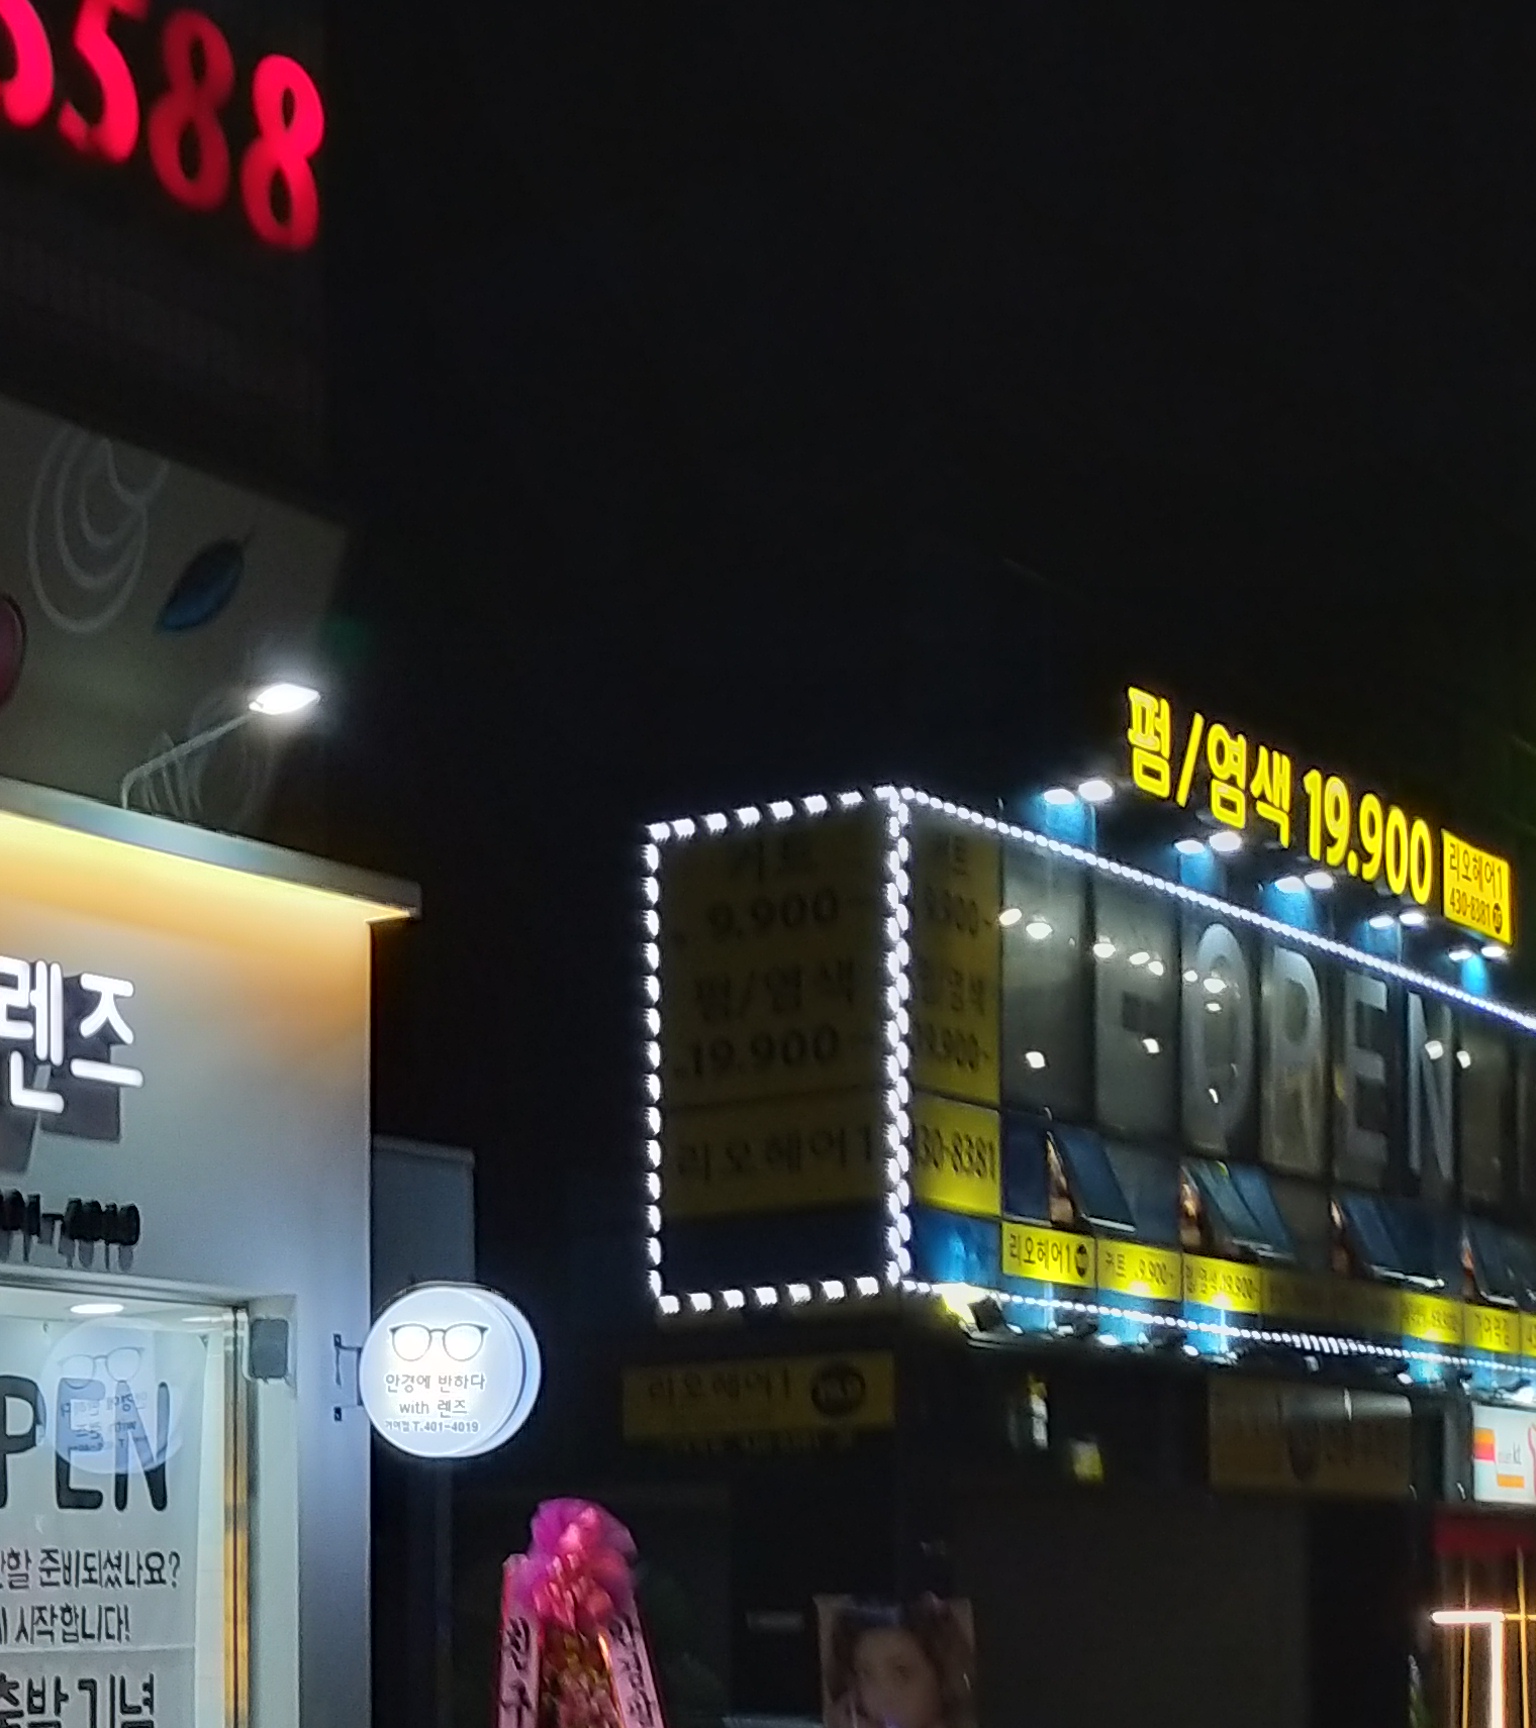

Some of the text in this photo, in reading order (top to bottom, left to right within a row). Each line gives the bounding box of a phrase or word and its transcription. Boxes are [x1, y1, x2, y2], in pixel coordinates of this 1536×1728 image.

[1126, 685, 1434, 905] 펌/염색 19.900
[1008, 1231, 1072, 1275] 리오헤어1
[385, 1372, 487, 1394] 안경에 반하다
[399, 1398, 468, 1419] with 렌즈
[37, 1547, 182, 1590] 준비되셨나요?
[14, 1602, 132, 1646] 시작합니다!
